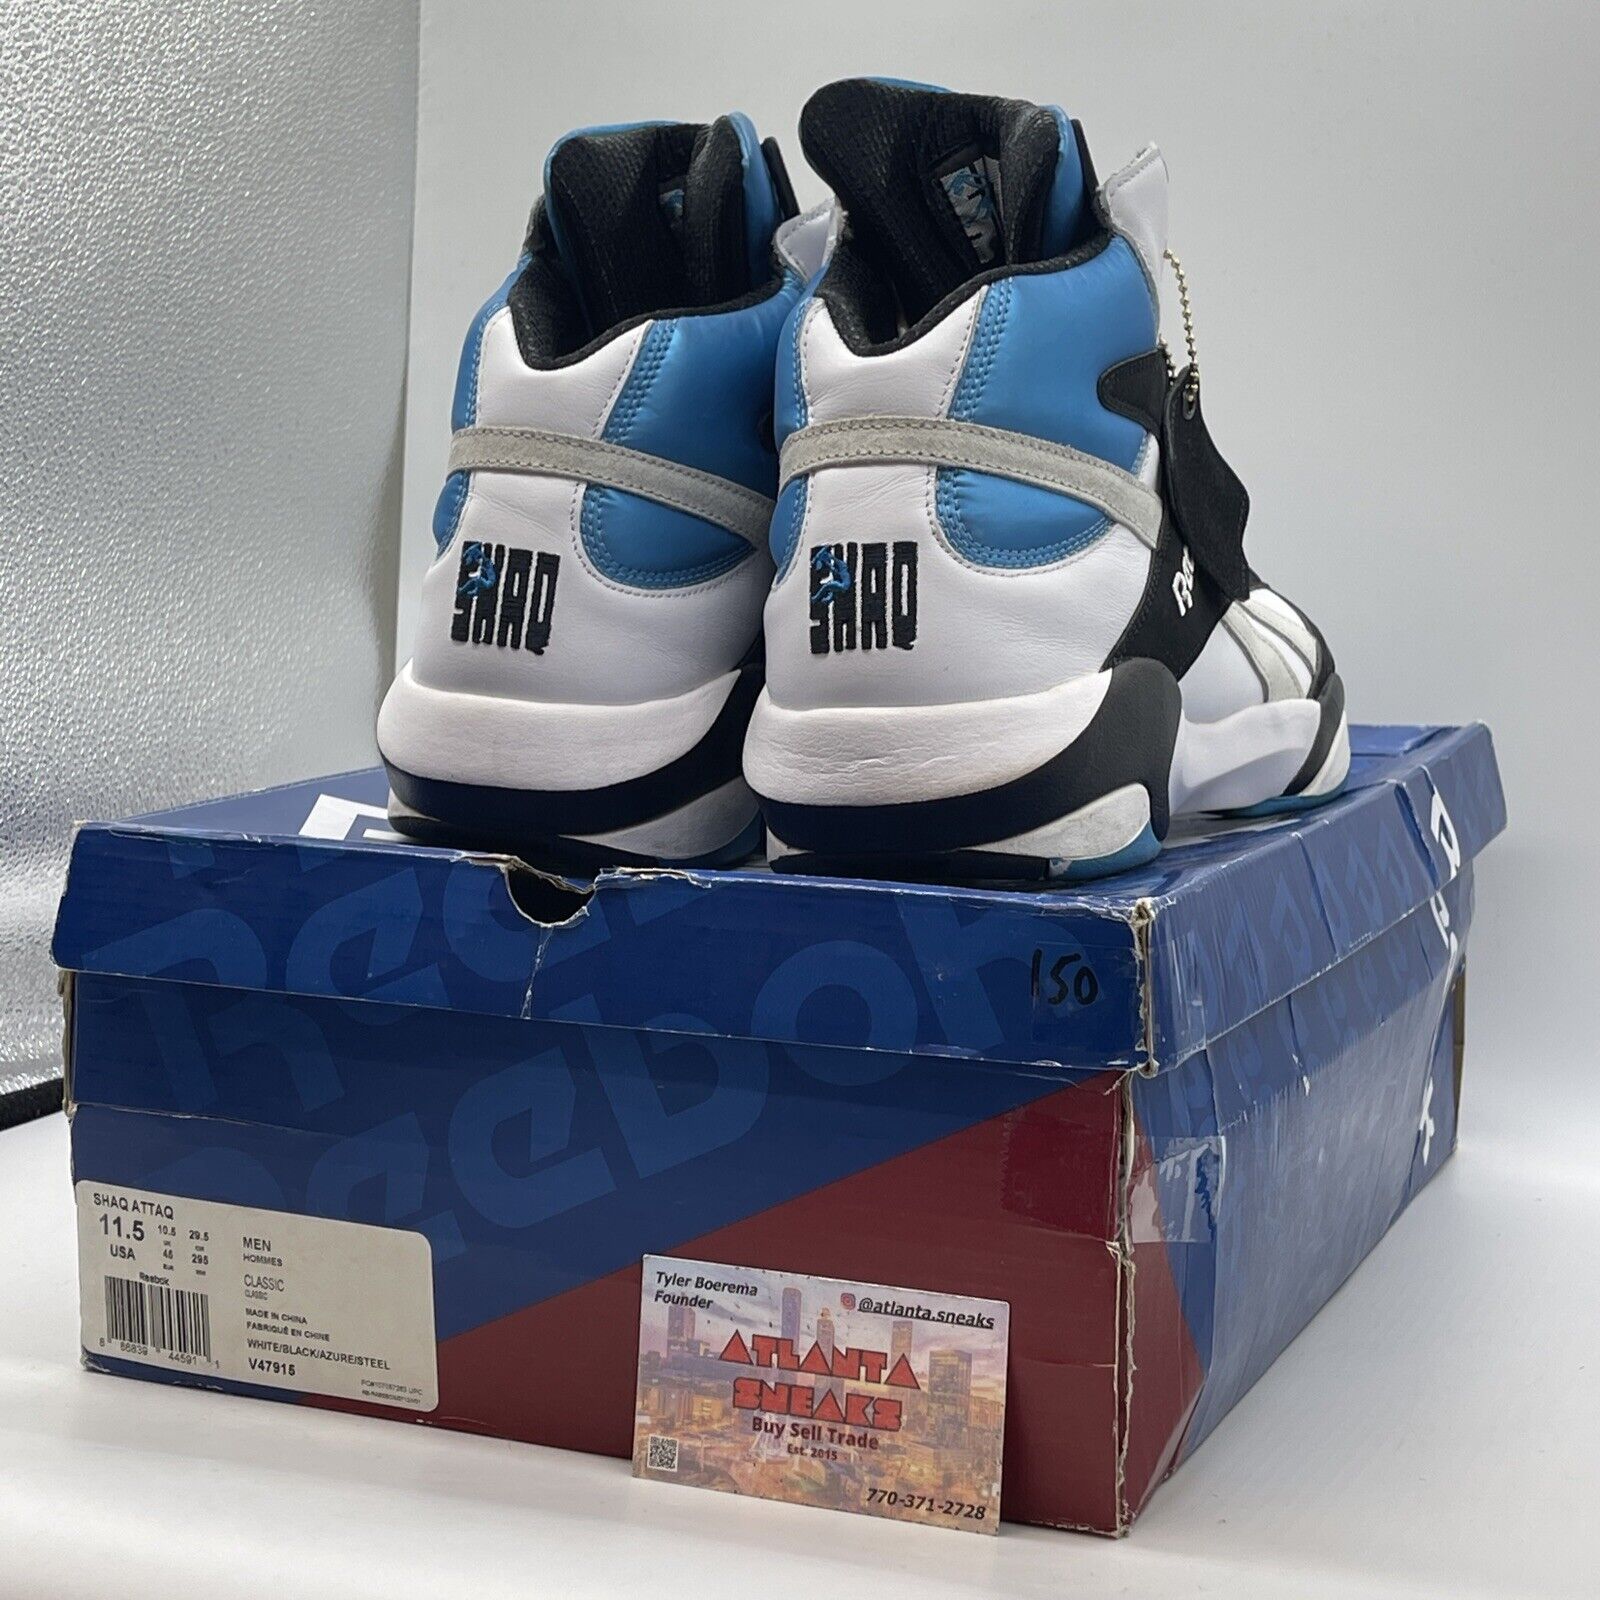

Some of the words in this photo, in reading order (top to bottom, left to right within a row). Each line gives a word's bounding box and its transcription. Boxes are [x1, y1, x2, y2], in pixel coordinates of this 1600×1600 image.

[451, 541, 560, 655] SHAQ
[809, 540, 918, 654] SHAQ
[1031, 948, 1099, 1006] 150
[93, 1192, 129, 1212] SHAQ
[132, 1199, 174, 1220] ATTAQ
[100, 1213, 145, 1242] 11.5
[158, 1224, 176, 1237] 10.5
[110, 1244, 136, 1261] USA
[243, 1236, 271, 1252] MEN
[243, 1253, 283, 1267] HOMMES
[139, 1271, 170, 1286] Reebok
[244, 1273, 285, 1292] CLASSIC
[656, 1271, 691, 1290] Tyler
[695, 1276, 758, 1297] Boerema
[654, 1291, 713, 1310] Founder
[857, 1297, 995, 1330] @atlanta.sneaks
[245, 1308, 268, 1319] MADE
[271, 1311, 280, 1321] IN
[281, 1313, 308, 1325] CHINA
[291, 1328, 302, 1337] EN
[304, 1330, 330, 1342] CHINE
[247, 1338, 391, 1371] WHITE/BLACK/AZURE/STEEL
[248, 1357, 297, 1377] V47915
[718, 1329, 921, 1390] ATLANTA
[733, 1377, 903, 1432] SNEAKS
[752, 1417, 784, 1440] Buy
[789, 1425, 822, 1442] Sell
[826, 1428, 880, 1451] Trade
[787, 1444, 808, 1456] Est.
[811, 1447, 838, 1462] 2015
[866, 1488, 986, 1520] 770-371-2728
